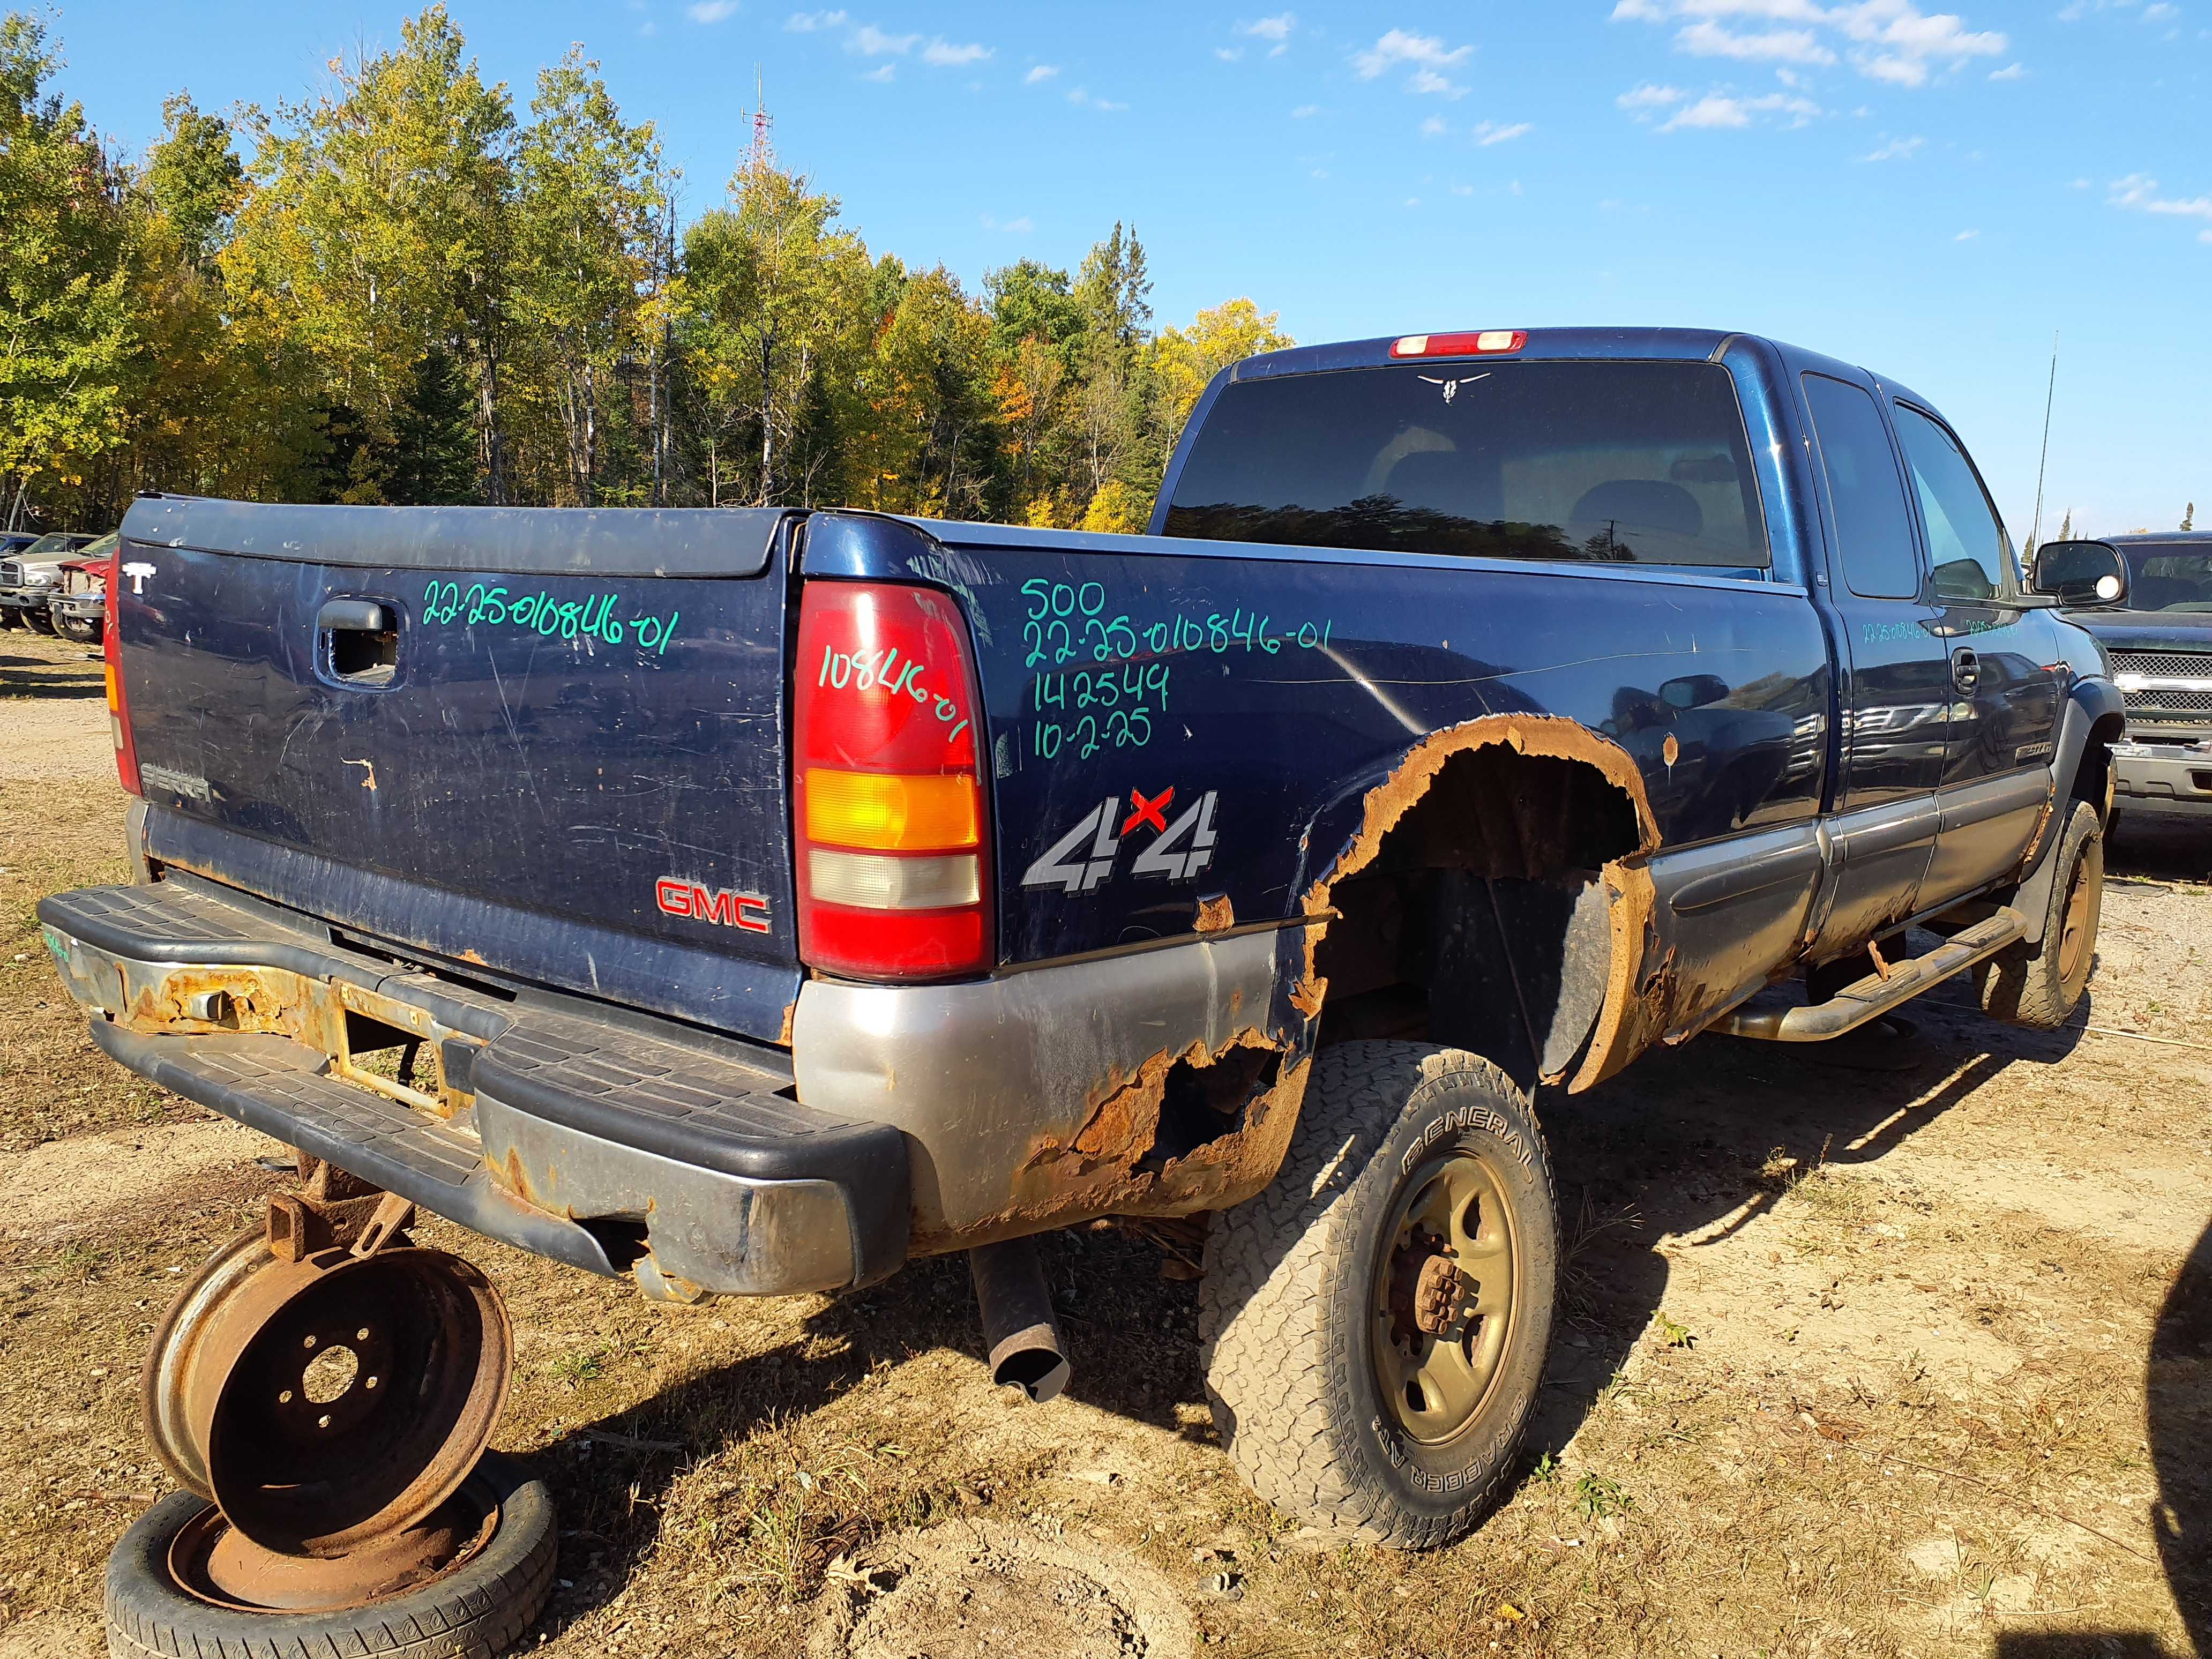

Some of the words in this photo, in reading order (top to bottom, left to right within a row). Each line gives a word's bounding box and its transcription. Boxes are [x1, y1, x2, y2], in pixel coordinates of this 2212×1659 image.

[1021, 579, 1105, 620] 500
[1035, 707, 1151, 759] 10-2-25
[140, 763, 212, 804] SIERRA
[655, 876, 772, 935] GMC
[1402, 1106, 1533, 1184] GENERAL
[1410, 1392, 1528, 1493] GRABBER
